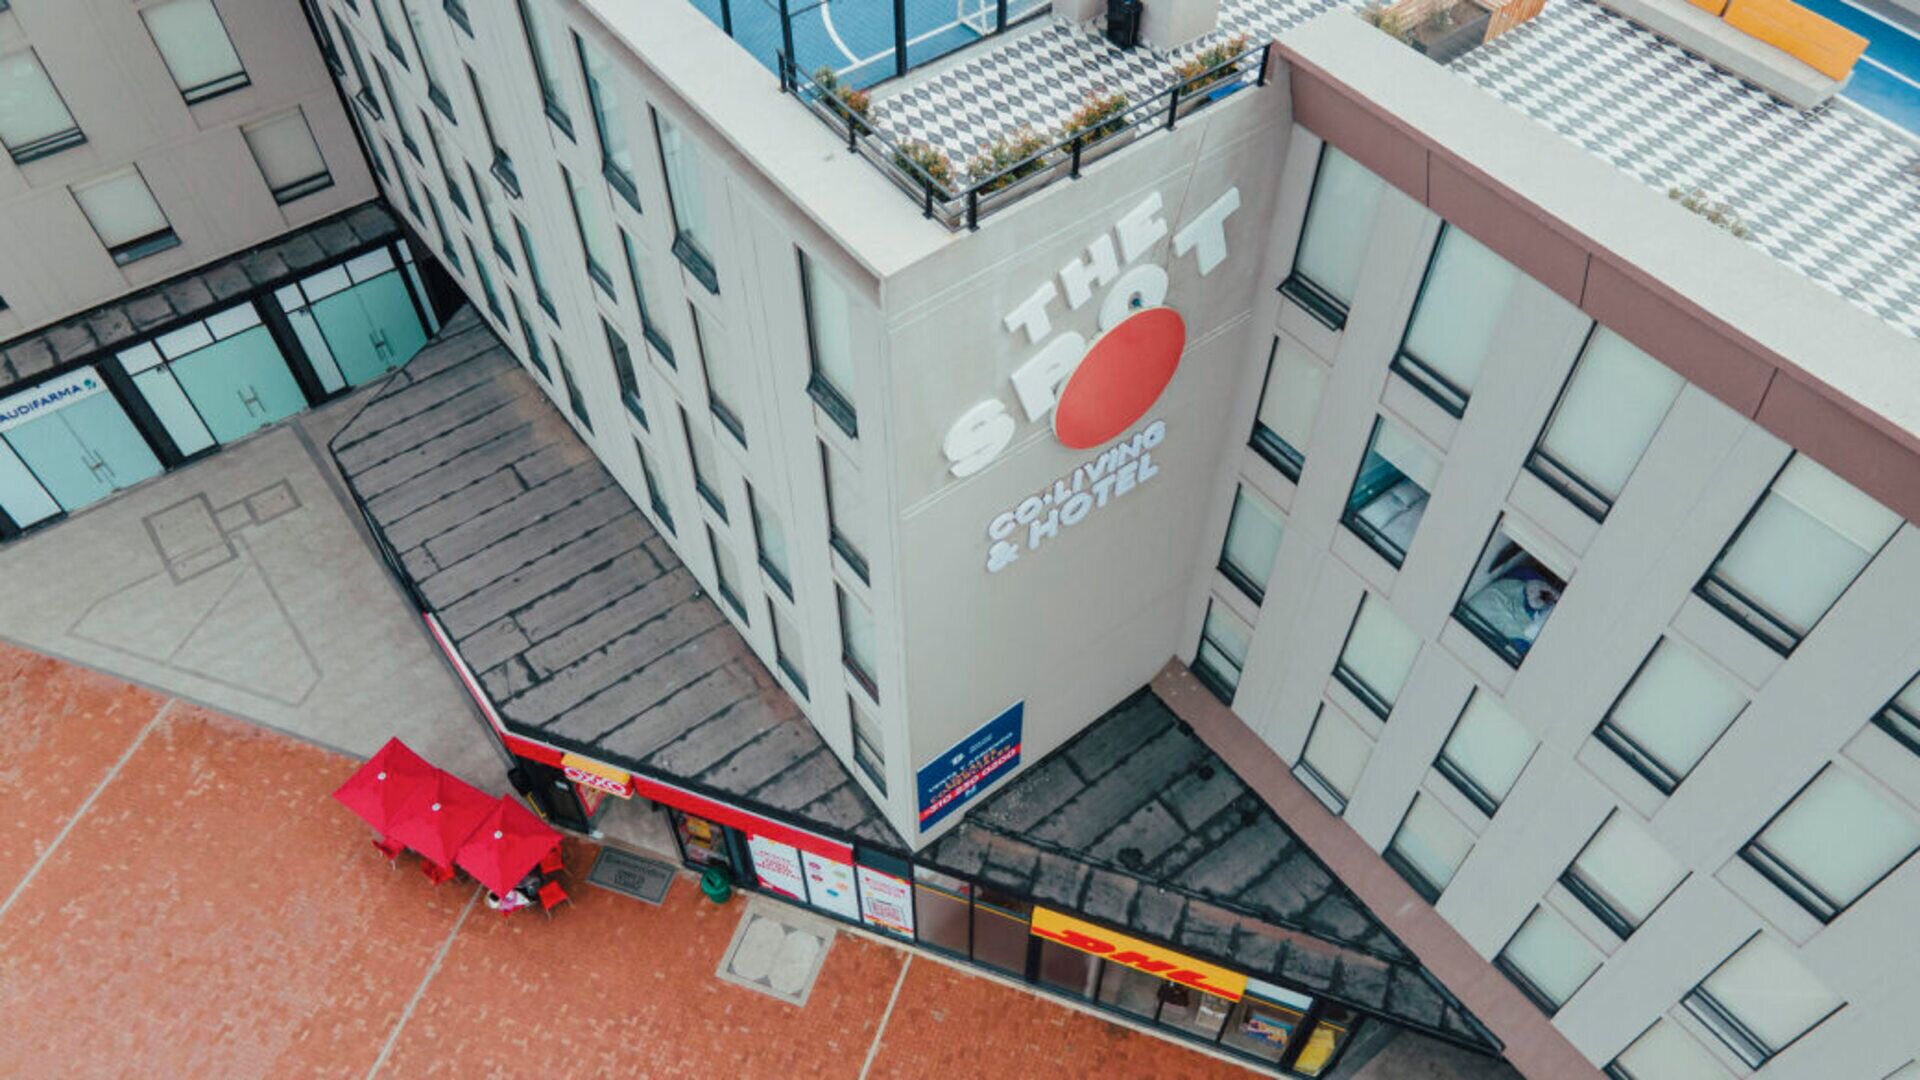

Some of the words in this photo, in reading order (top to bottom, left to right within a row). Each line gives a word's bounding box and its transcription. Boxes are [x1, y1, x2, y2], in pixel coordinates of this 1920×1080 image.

[1003, 191, 1168, 345] THE
[943, 187, 1240, 477] SPOT
[0, 384, 81, 422] AUDIFARMA
[986, 540, 1019, 573] &
[1028, 452, 1160, 550] HOTEL
[1061, 930, 1209, 985] DHL
